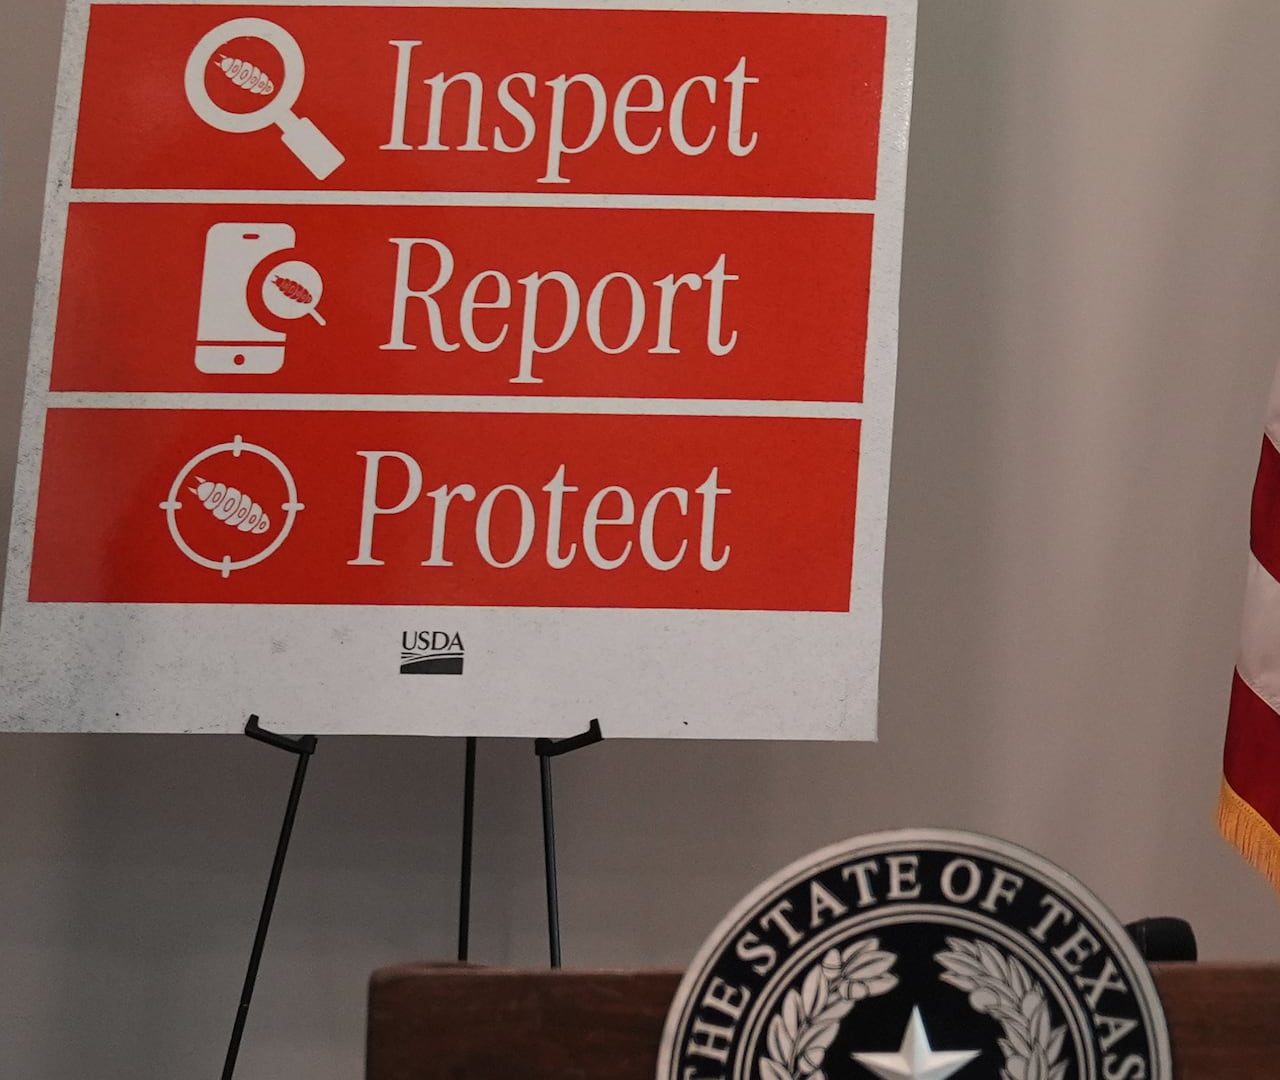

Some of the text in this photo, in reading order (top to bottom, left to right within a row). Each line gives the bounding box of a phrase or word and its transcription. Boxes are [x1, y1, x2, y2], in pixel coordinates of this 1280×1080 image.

[379, 40, 760, 184] Inspect
[379, 237, 739, 384] Report
[347, 450, 732, 572] Protect
[402, 630, 465, 651] USDA
[736, 855, 921, 976] STATE
[940, 858, 1024, 914] OF
[1029, 893, 1148, 1080] TEXAS
